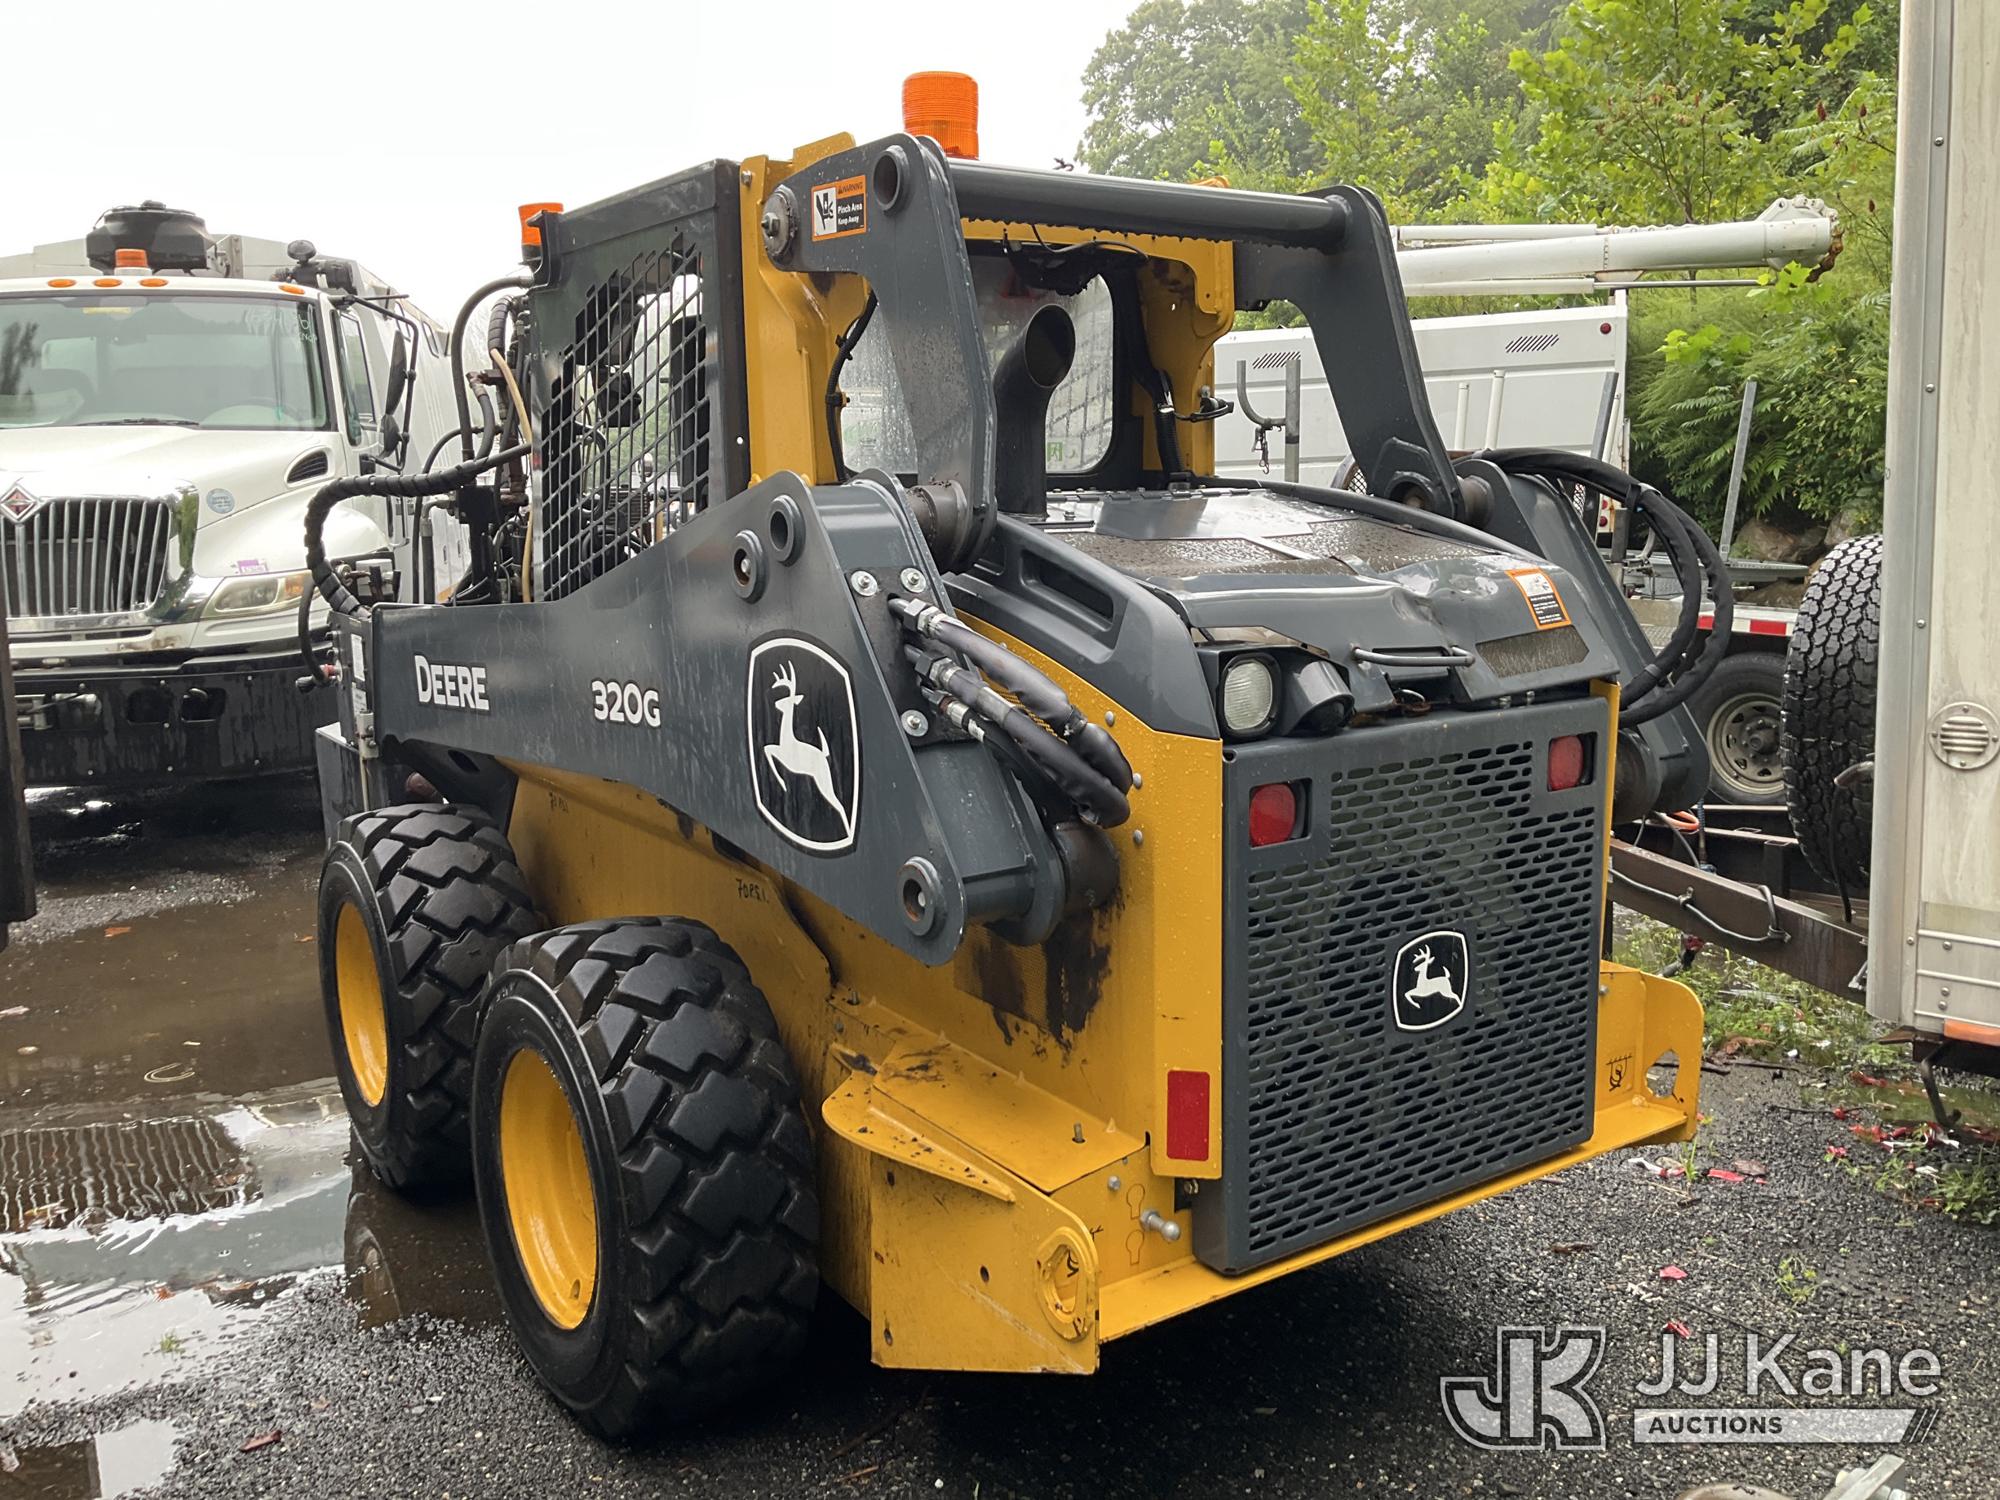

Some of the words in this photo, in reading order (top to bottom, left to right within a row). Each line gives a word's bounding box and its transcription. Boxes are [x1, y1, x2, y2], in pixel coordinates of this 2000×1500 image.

[837, 204, 851, 214] Pinch
[851, 203, 863, 211] Area
[848, 215, 860, 223] Away
[591, 680, 661, 728] 320G
